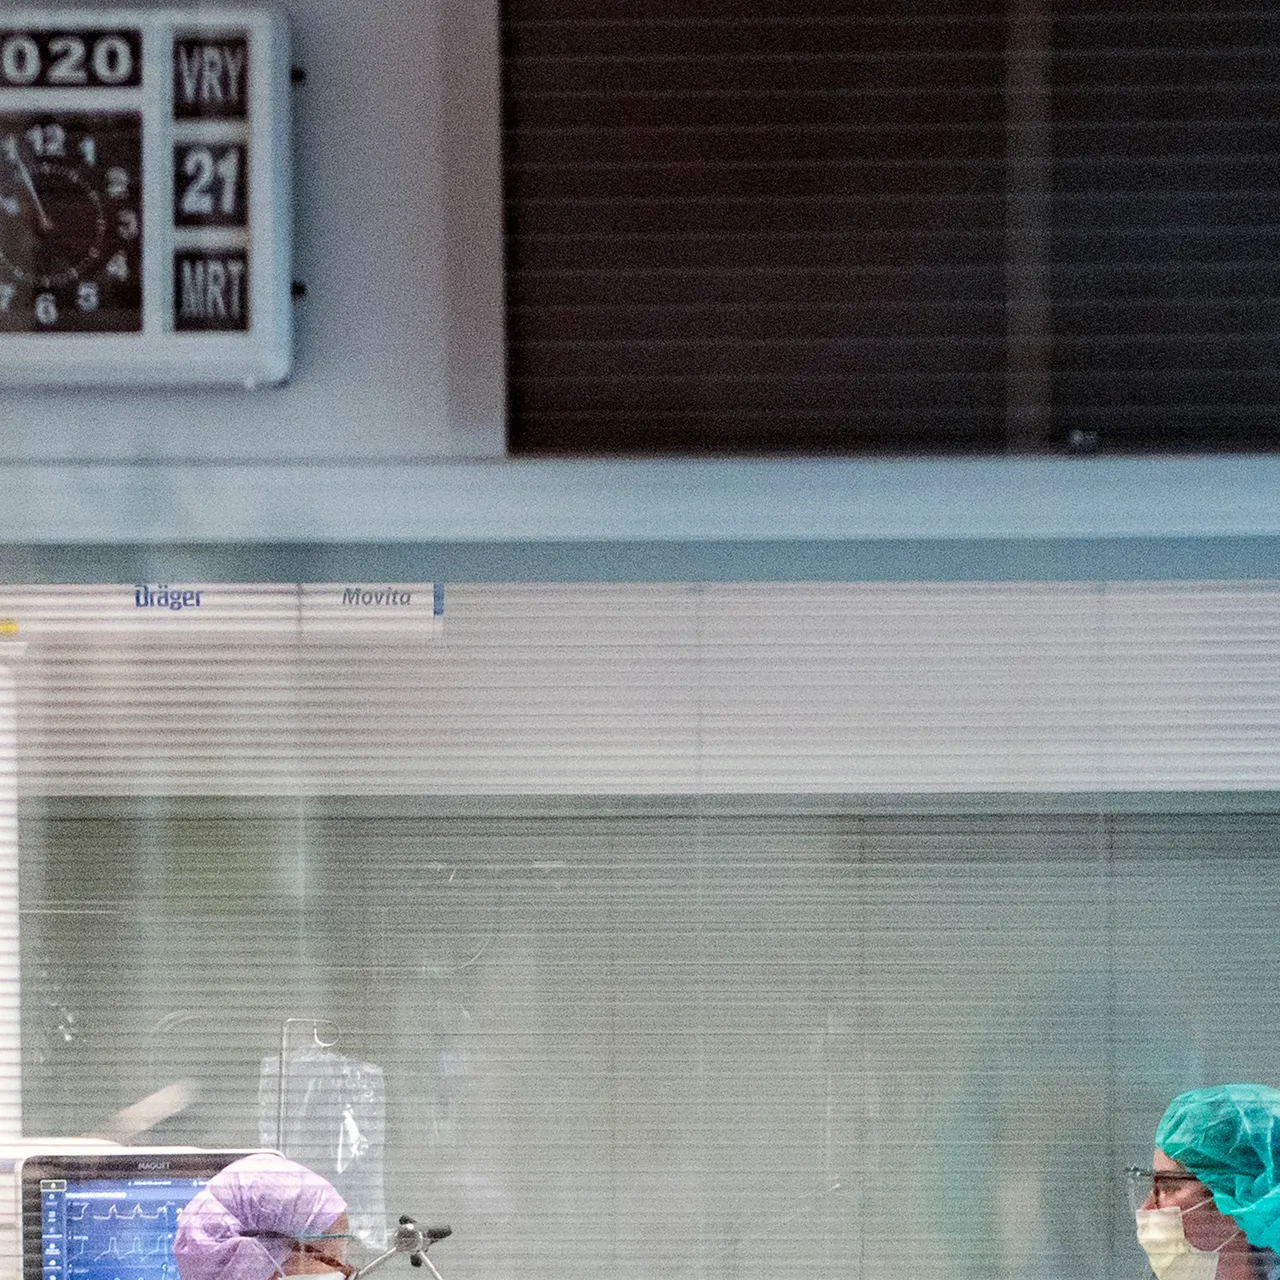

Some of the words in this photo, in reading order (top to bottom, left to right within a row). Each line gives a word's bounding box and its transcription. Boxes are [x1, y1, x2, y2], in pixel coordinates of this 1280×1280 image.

[177, 44, 244, 103] VRY
[28, 123, 66, 157] 12
[80, 138, 96, 166] 1
[105, 166, 131, 199] 2
[181, 148, 241, 215] 21
[119, 210, 139, 240] 3
[105, 250, 129, 282] 4
[76, 281, 99, 312] 5
[181, 260, 244, 319] MRT
[35, 293, 58, 324] 6
[134, 584, 204, 611] Dräger
[341, 586, 413, 607] Movita
[137, 1161, 171, 1170] MAQUET
